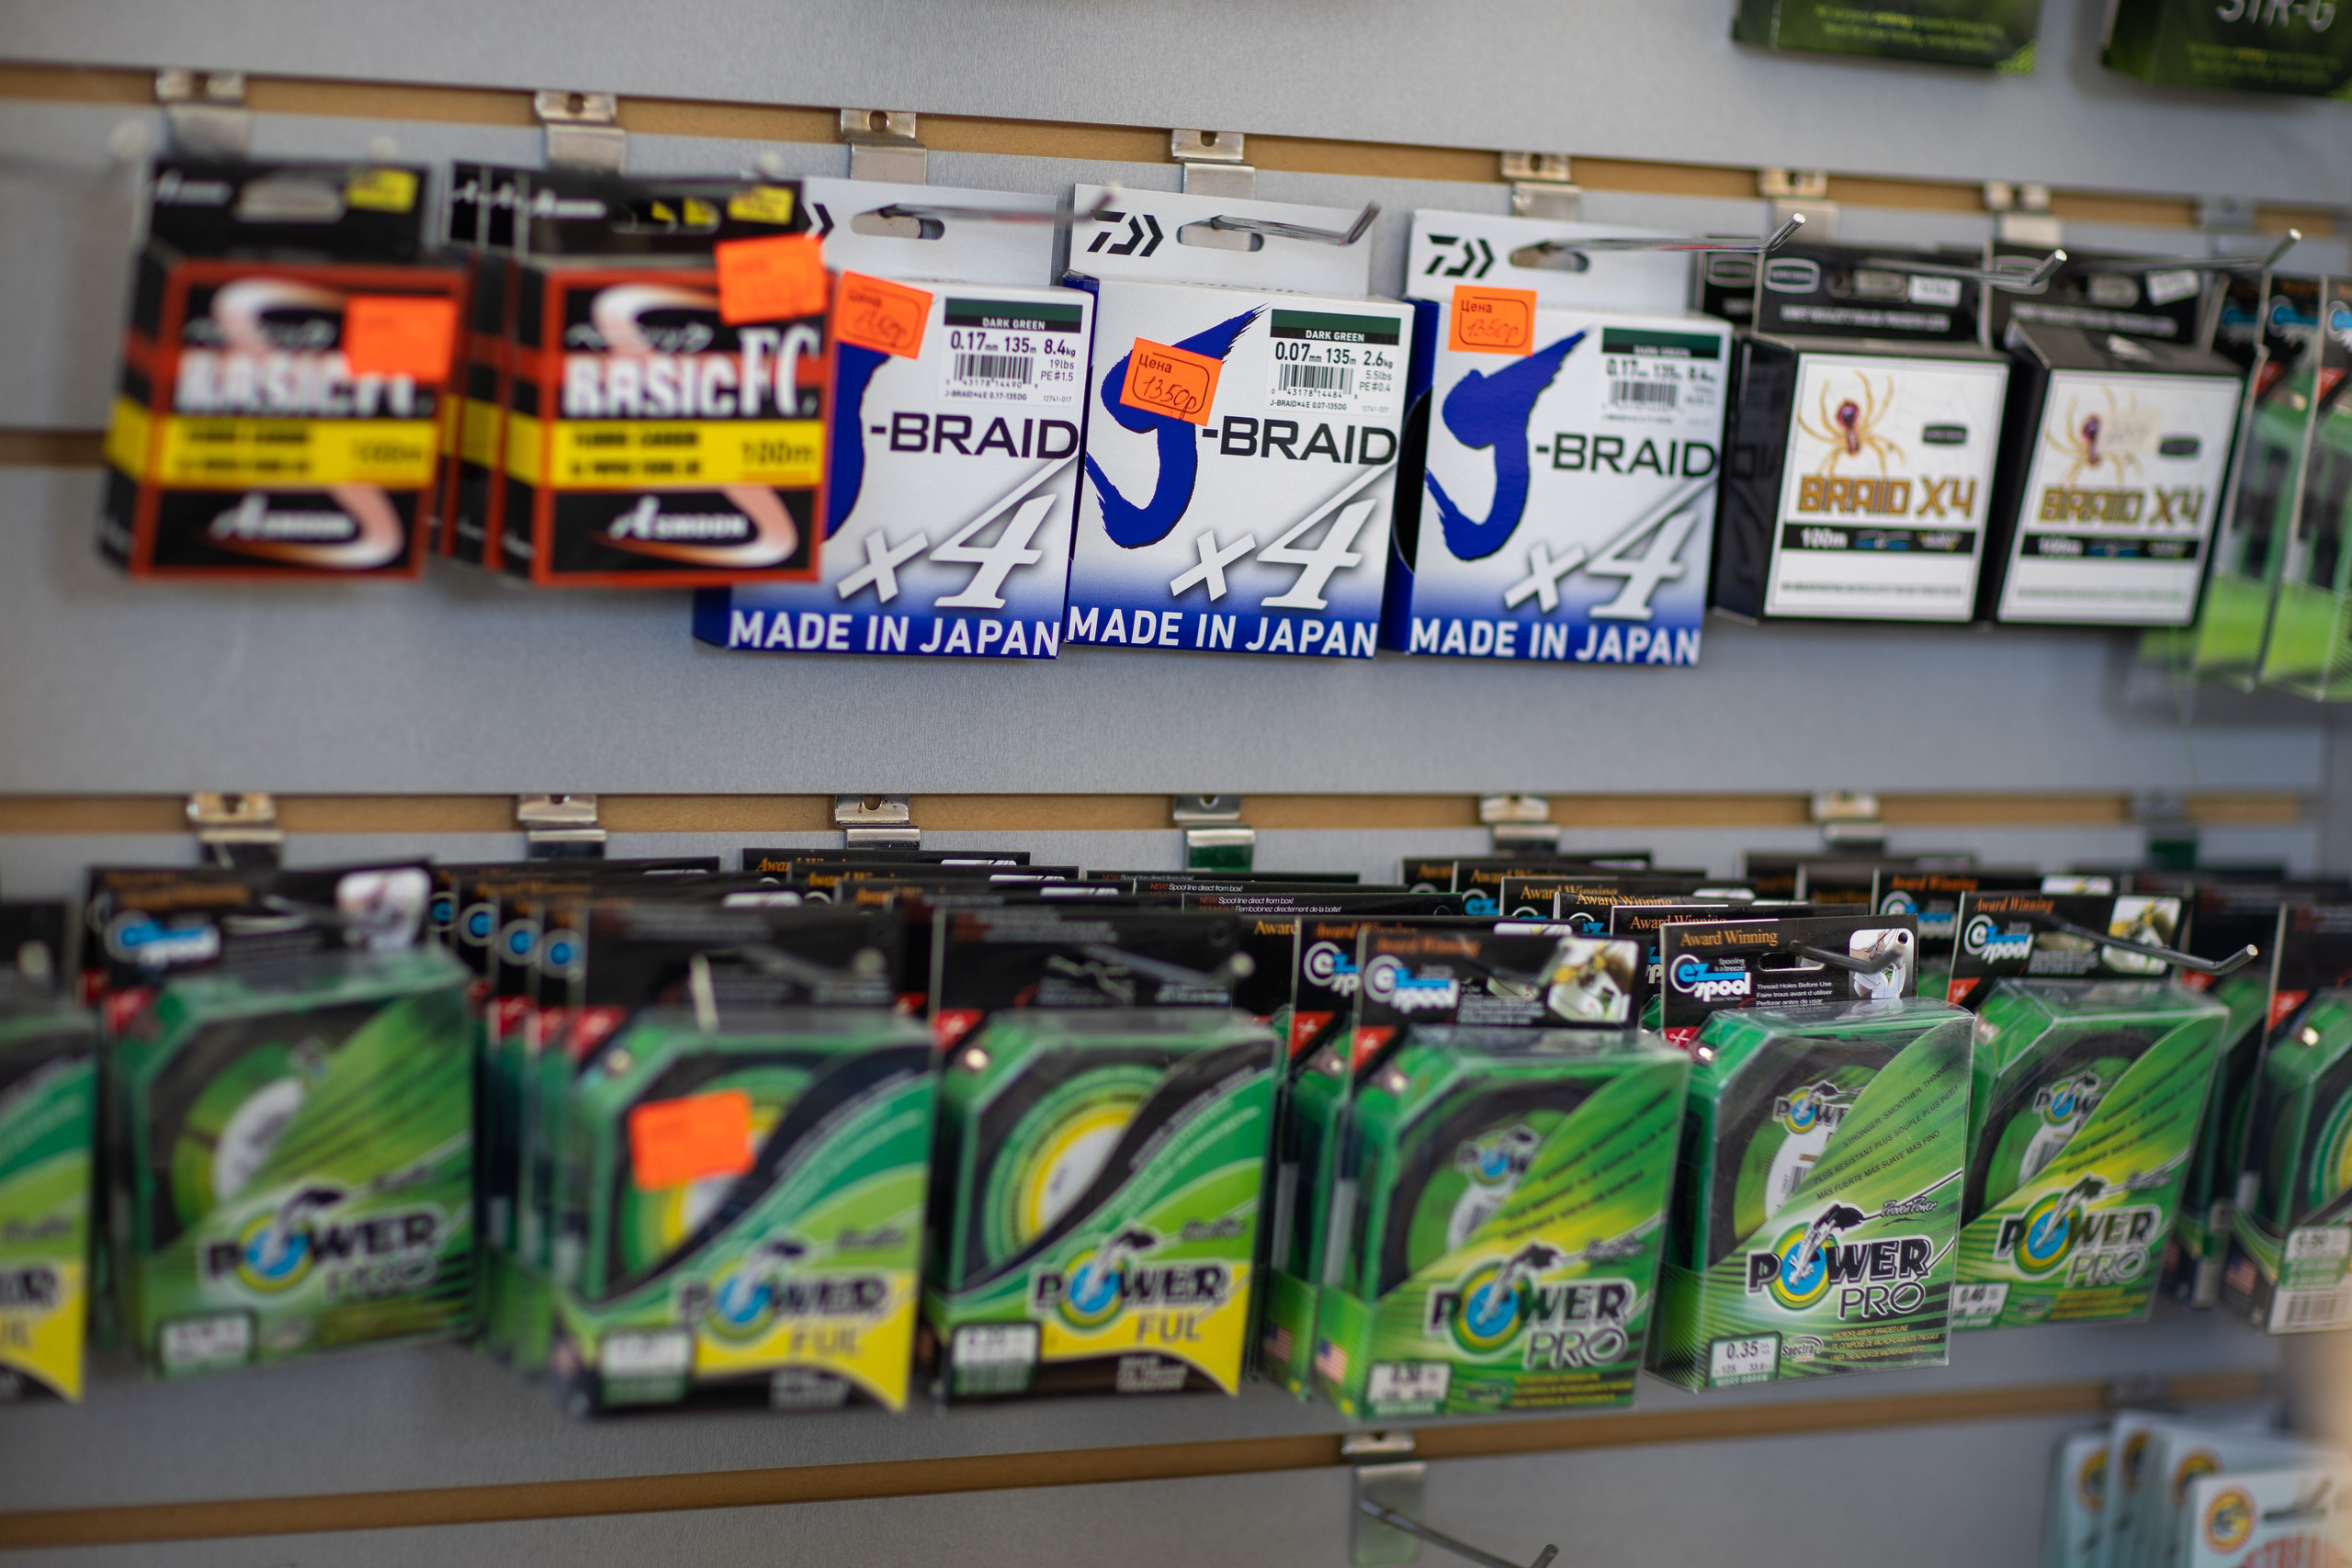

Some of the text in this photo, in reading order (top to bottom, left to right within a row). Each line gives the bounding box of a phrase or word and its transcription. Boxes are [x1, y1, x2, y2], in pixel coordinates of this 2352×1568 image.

[1461, 299, 1493, 313] Цена
[982, 317, 1046, 331] DARK GREEN
[1306, 329, 1365, 343] DARK GREEN
[1004, 336, 1037, 355] 135m
[1044, 338, 1077, 358] 8.4kg
[1326, 348, 1357, 366] 135m
[1363, 350, 1394, 369] 2.6kg
[1049, 358, 1075, 370] 19lbs
[1138, 353, 1173, 374] Цена
[1365, 370, 1393, 381] 5.5lbs
[561, 353, 738, 419] BASIC
[1286, 389, 1314, 397] 43178
[1317, 389, 1343, 399] 14484
[1798, 475, 1976, 519] BRAID X4
[2039, 486, 2144, 525] BRAID
[1801, 526, 1849, 550] 100m
[728, 609, 1060, 657] MADE IN JAPAN
[1067, 605, 1378, 658] MADE IN JAPAN
[1408, 616, 1700, 666] MADE IN JAPAN
[1169, 883, 1187, 892] Spool
[1576, 893, 1619, 907] Award
[1218, 897, 1237, 906] Spool
[1974, 896, 2055, 915] Award Winning
[1679, 930, 1779, 947] Award Winning
[1694, 971, 1751, 1002] spool
[1841, 1059, 1954, 1149] STRONGER SMOOTHER THINNER
[1814, 1083, 1961, 1186] PLUS RESISTANT PLUS SOUPLE PLUS PETIT
[1834, 1173, 1864, 1195] FUERTE
[1882, 1149, 1905, 1169] SUAVE
[1922, 1128, 1941, 1145] FINO
[1995, 1198, 2160, 1277] POWER
[1747, 1227, 1931, 1304] POWER
[2064, 1245, 2151, 1288] PRO
[1031, 1257, 1227, 1325] POWER
[1838, 1280, 1927, 1320] PRO
[1425, 1266, 1636, 1359] POWER
[1136, 1312, 1202, 1344] FUL
[1896, 1324, 1909, 1332] LINE
[1522, 1326, 1629, 1370] PRO
[1726, 1339, 1758, 1359] 0.35
[1782, 1342, 1815, 1358] Spectra
